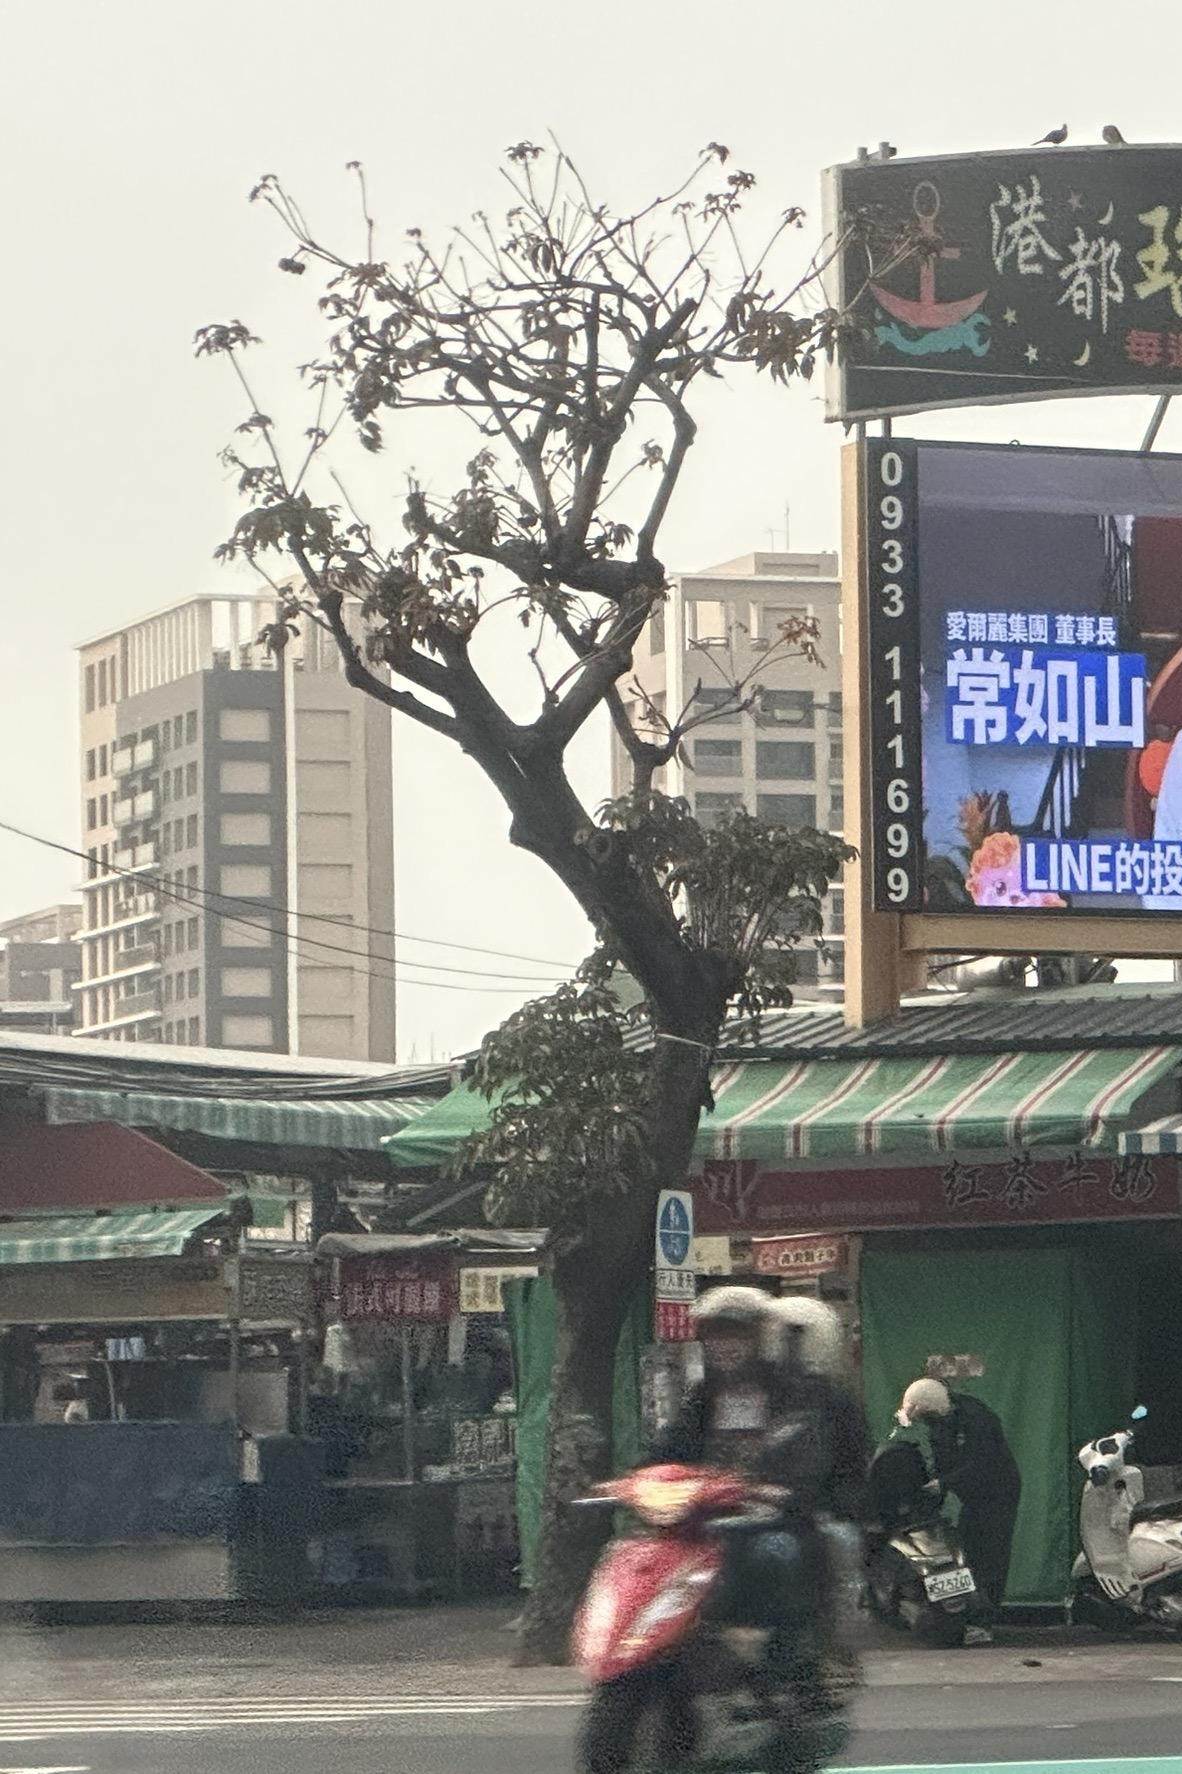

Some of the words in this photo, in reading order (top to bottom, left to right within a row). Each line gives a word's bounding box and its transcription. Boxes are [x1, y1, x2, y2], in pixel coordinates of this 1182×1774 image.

[989, 174, 1125, 335] 港都
[880, 451, 904, 618] 0933
[946, 610, 1049, 645] 愛爾麗集團
[1054, 614, 1117, 646] 董事長
[946, 647, 1145, 748] 常如山
